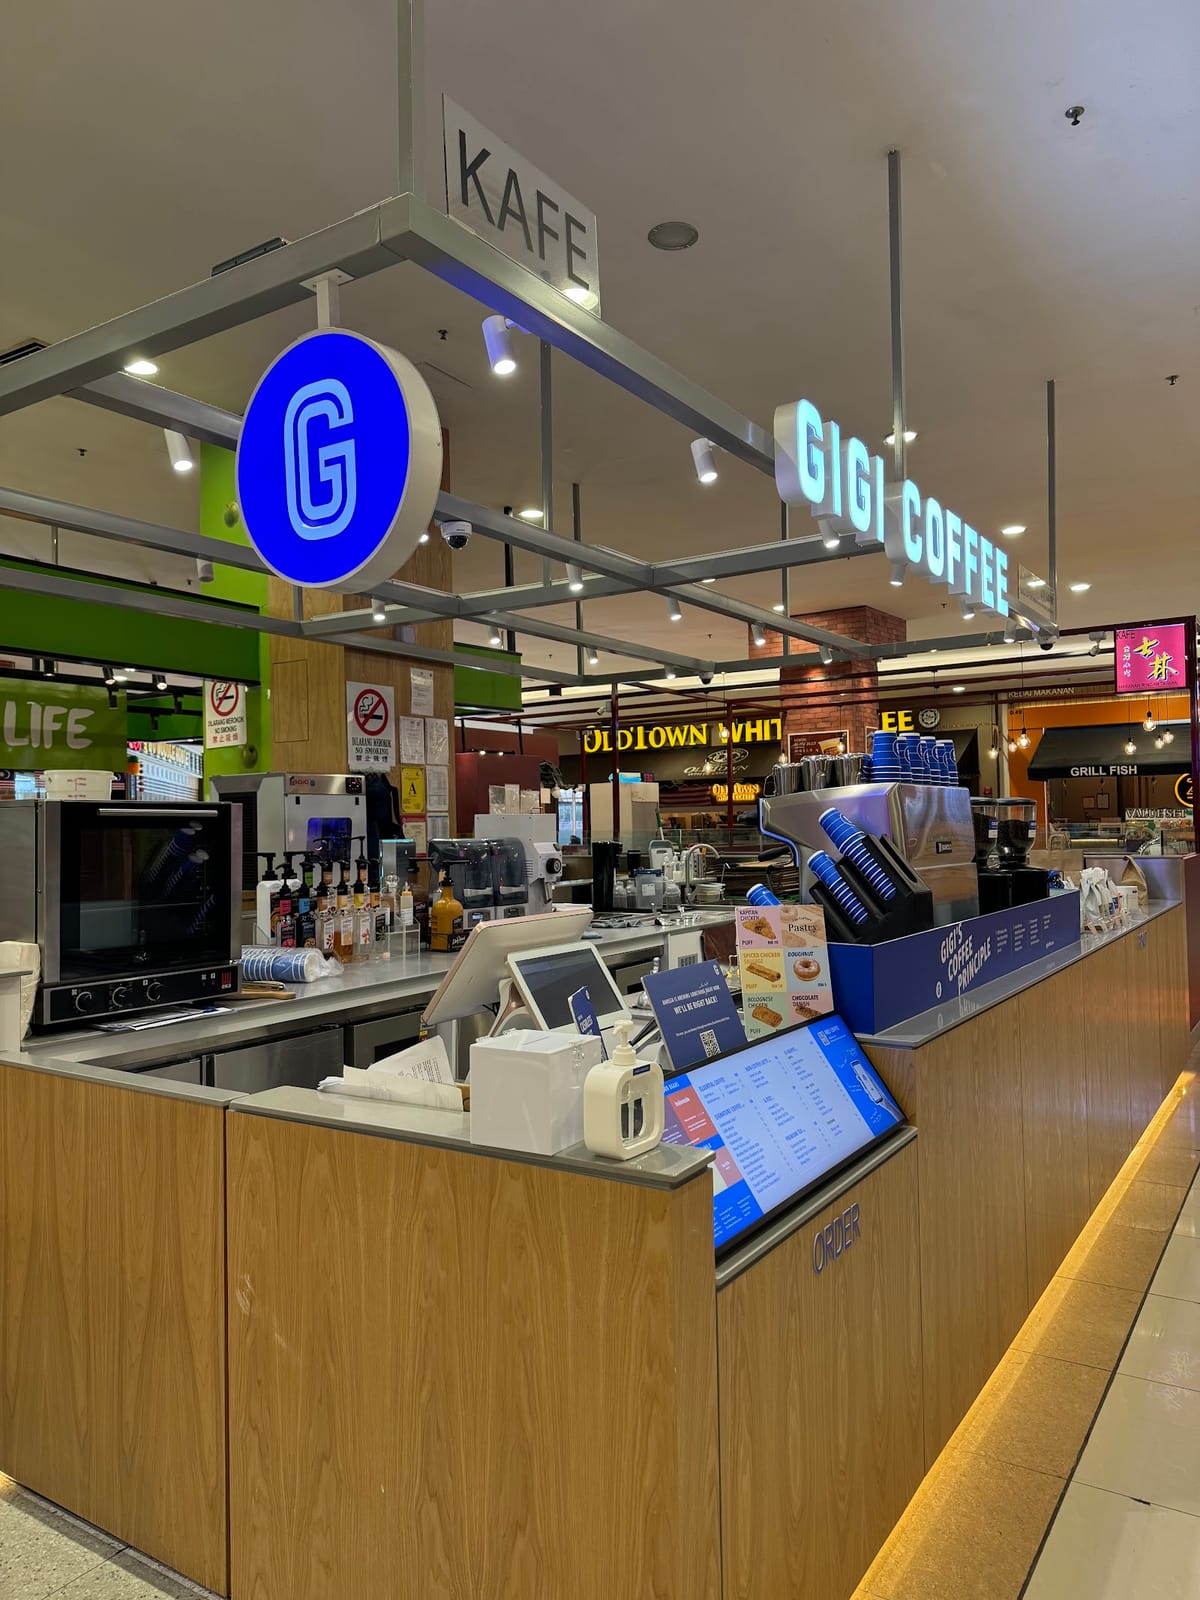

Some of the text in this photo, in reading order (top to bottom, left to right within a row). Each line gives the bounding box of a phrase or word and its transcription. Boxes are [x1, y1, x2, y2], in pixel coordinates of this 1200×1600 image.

[458, 128, 590, 291] KAFE
[283, 378, 357, 541] G
[796, 398, 1009, 618] GIGI COFFEE
[1033, 687, 1075, 697] MAKANAN
[3, 700, 95, 750] LIFE
[351, 736, 392, 748] DILARANG MEROKOK
[364, 747, 389, 755] SMOKING
[1070, 765, 1138, 777] GRILL FISH
[788, 923, 818, 935] Pastry
[940, 922, 963, 964] GIGI'S
[948, 934, 973, 982] COFFEE
[957, 936, 991, 997] PRINCIPLE
[812, 1201, 862, 1275] ORDER
